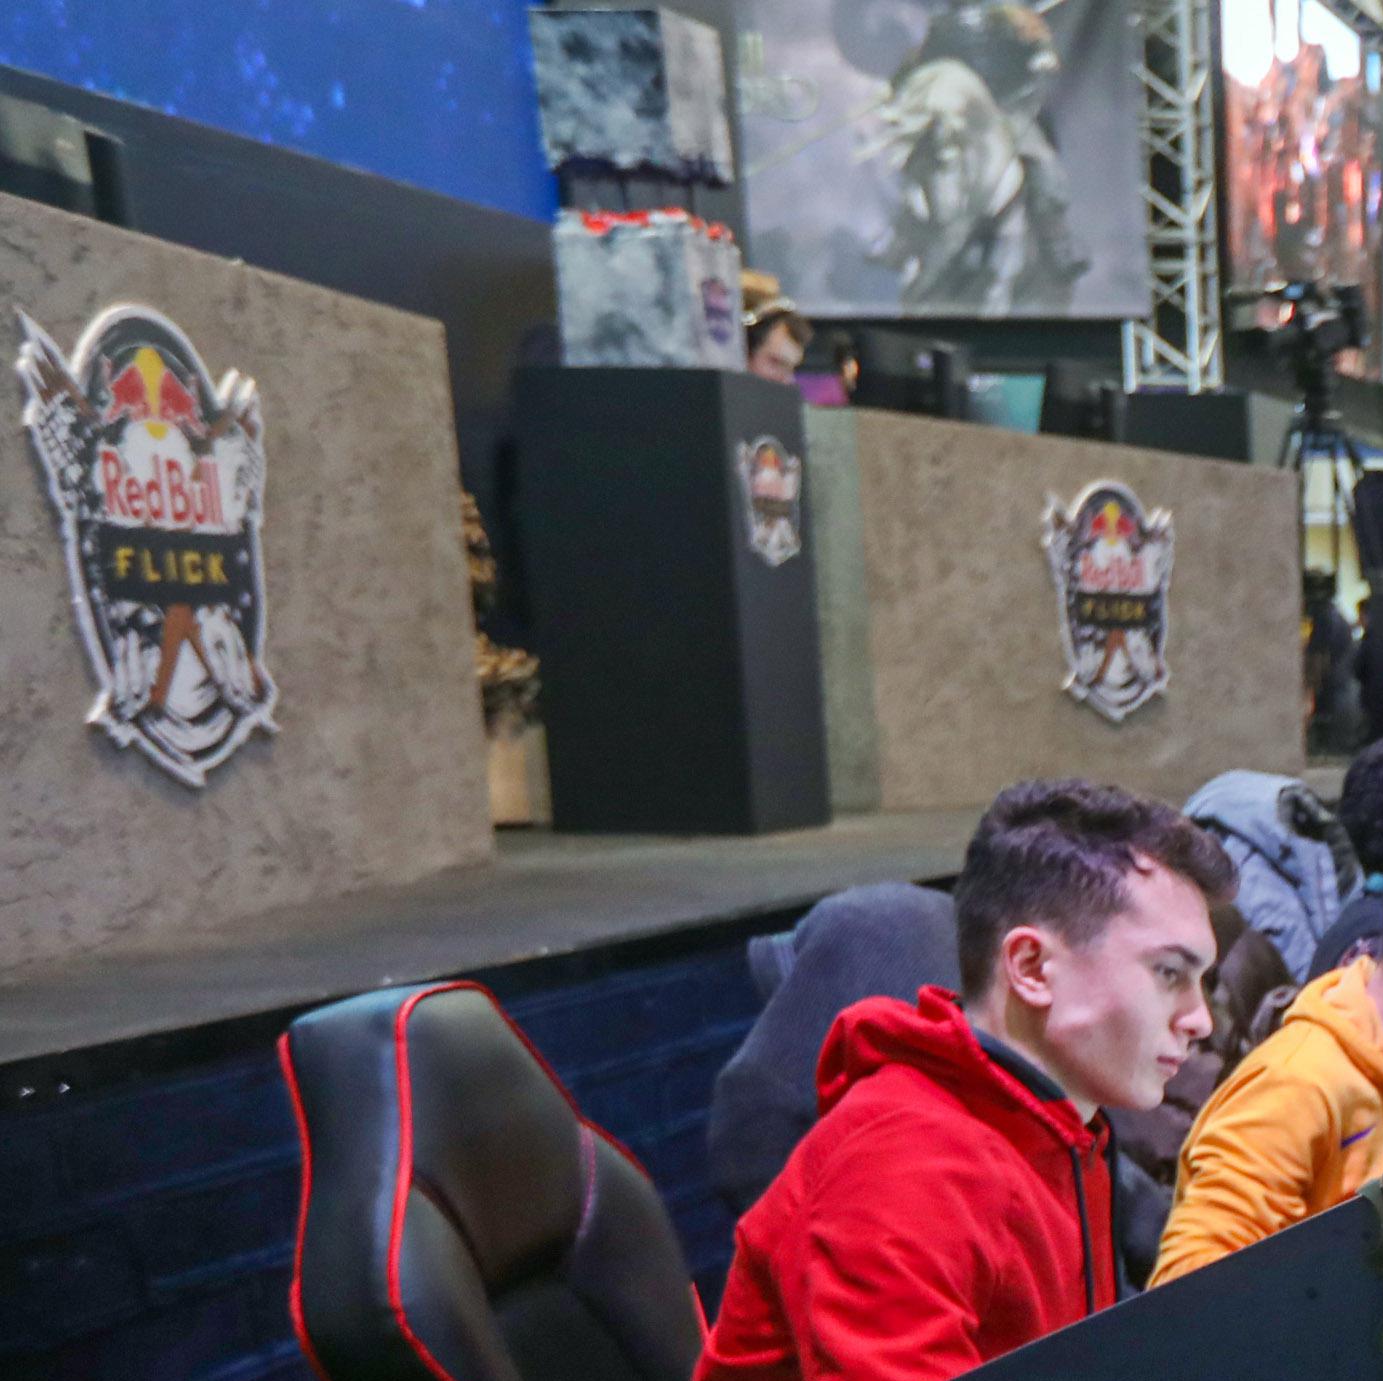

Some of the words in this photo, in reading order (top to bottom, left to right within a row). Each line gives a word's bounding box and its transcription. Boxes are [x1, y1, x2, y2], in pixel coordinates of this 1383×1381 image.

[101, 450, 165, 519] Red
[166, 458, 224, 524] Bull
[114, 546, 229, 585] FLICK
